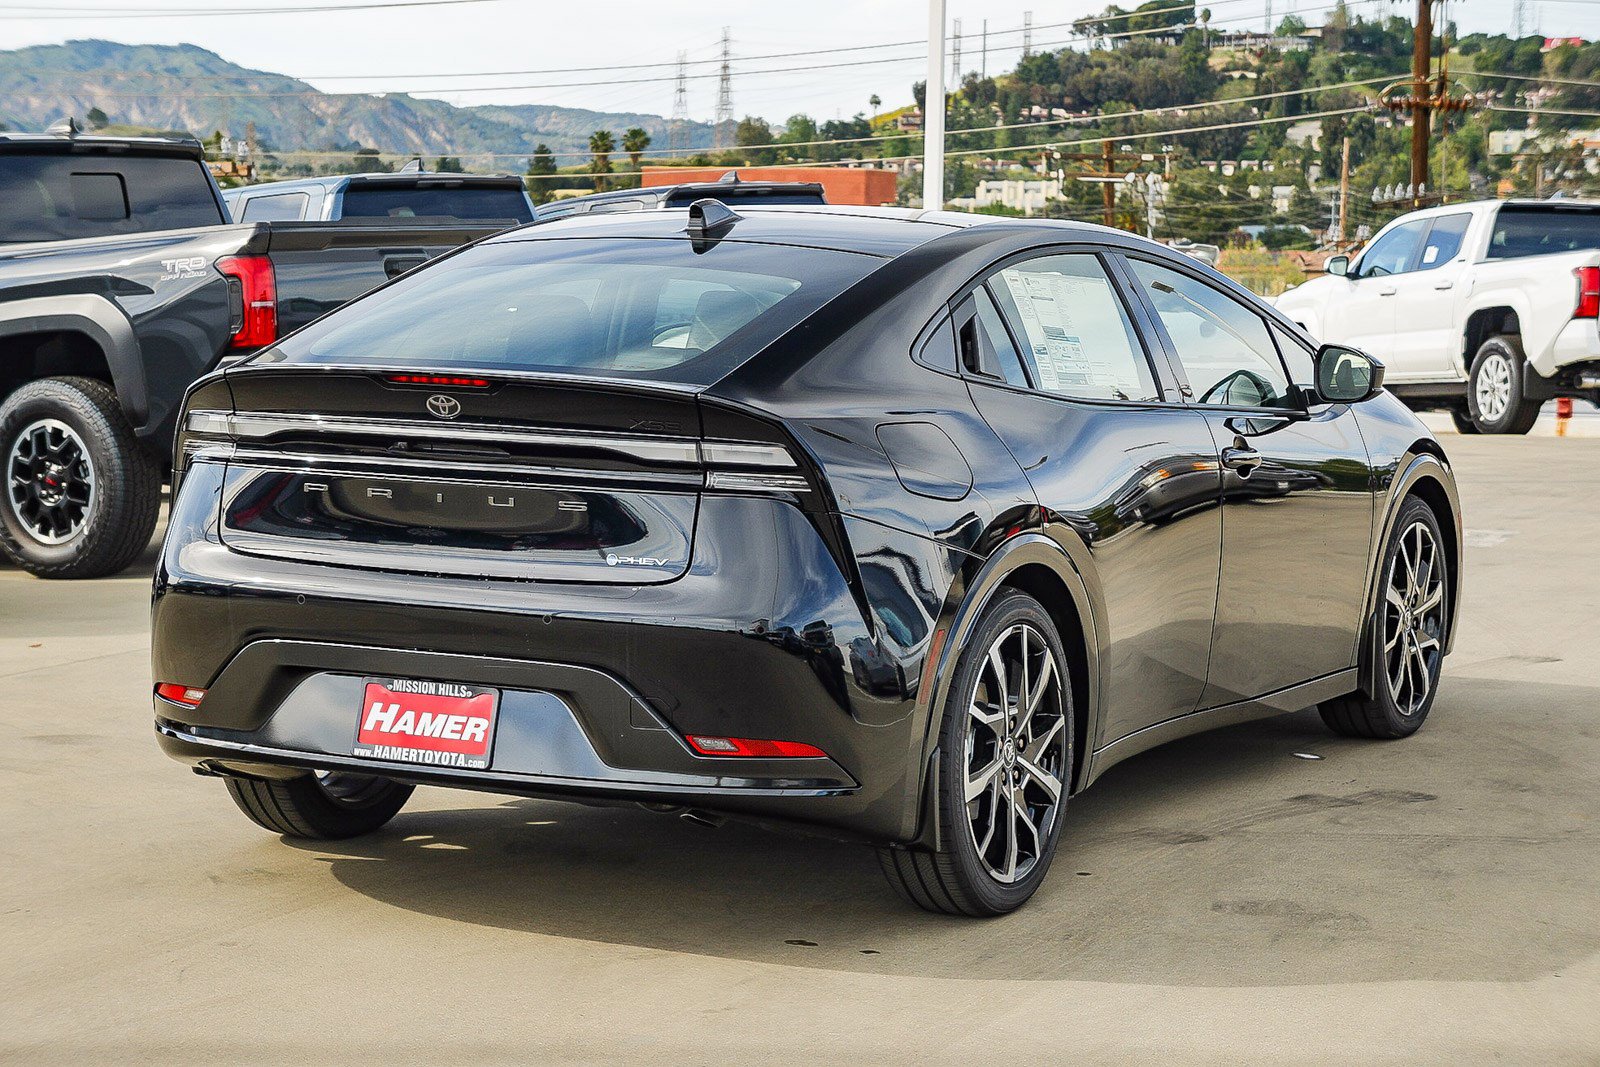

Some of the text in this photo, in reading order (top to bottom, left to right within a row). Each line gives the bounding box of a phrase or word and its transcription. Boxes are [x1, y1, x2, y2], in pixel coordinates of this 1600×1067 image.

[160, 257, 206, 273] TRD
[303, 482, 588, 512] PRIUS
[618, 556, 669, 567] PHEV
[392, 680, 468, 698] MISSION HILLS
[363, 702, 489, 743] HAMER
[353, 745, 485, 769] www.HAMERTOYOTA.com
